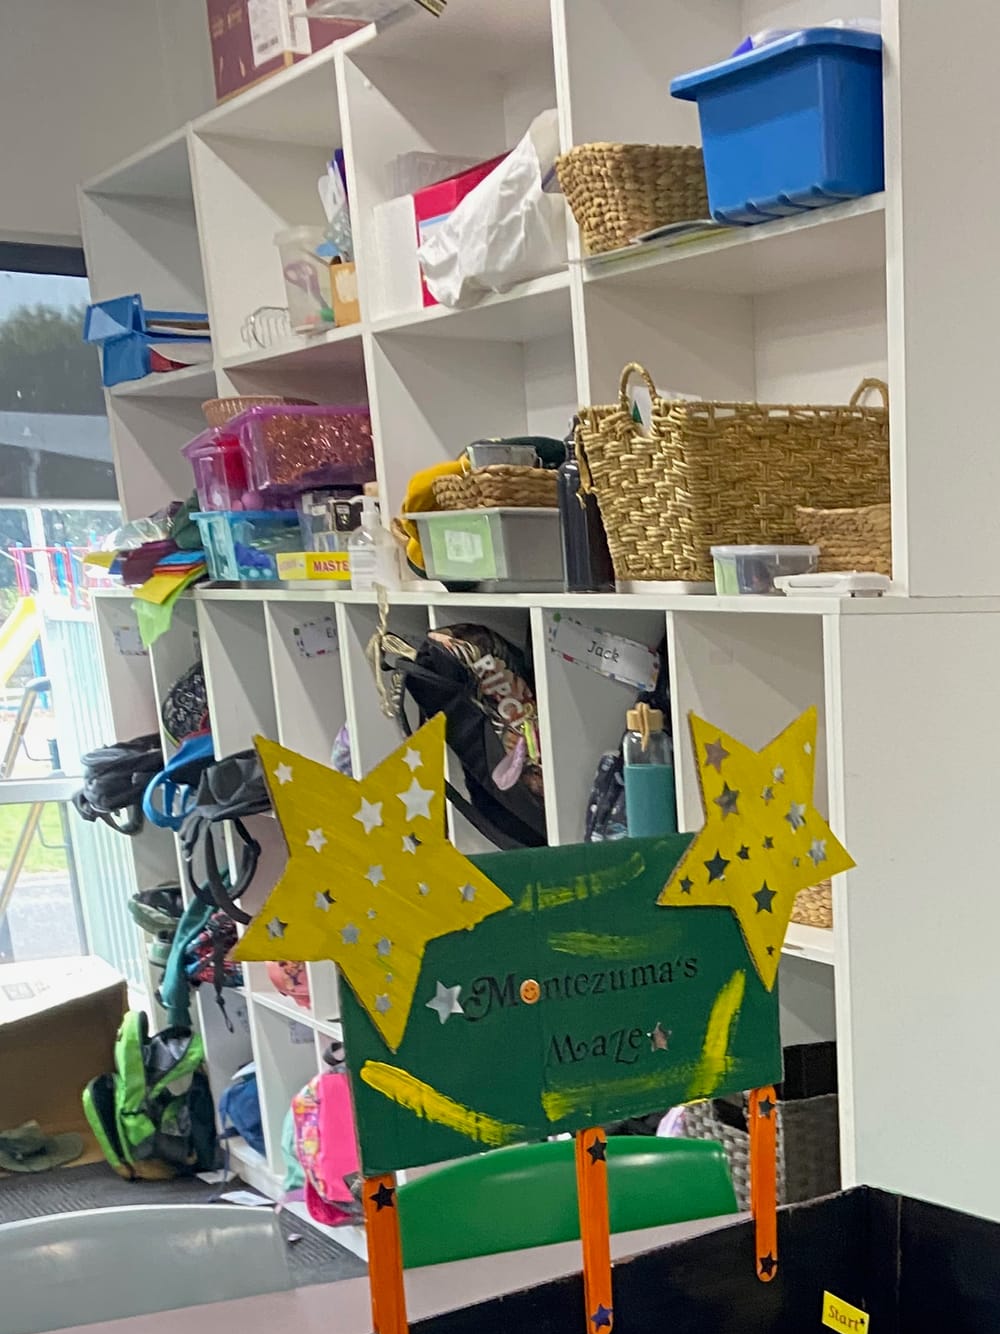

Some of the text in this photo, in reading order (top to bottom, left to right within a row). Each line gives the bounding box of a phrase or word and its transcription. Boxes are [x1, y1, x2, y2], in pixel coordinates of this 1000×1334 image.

[587, 640, 619, 663] Jack
[463, 956, 699, 1022] Mntezuma's
[828, 1304, 861, 1332] Start
